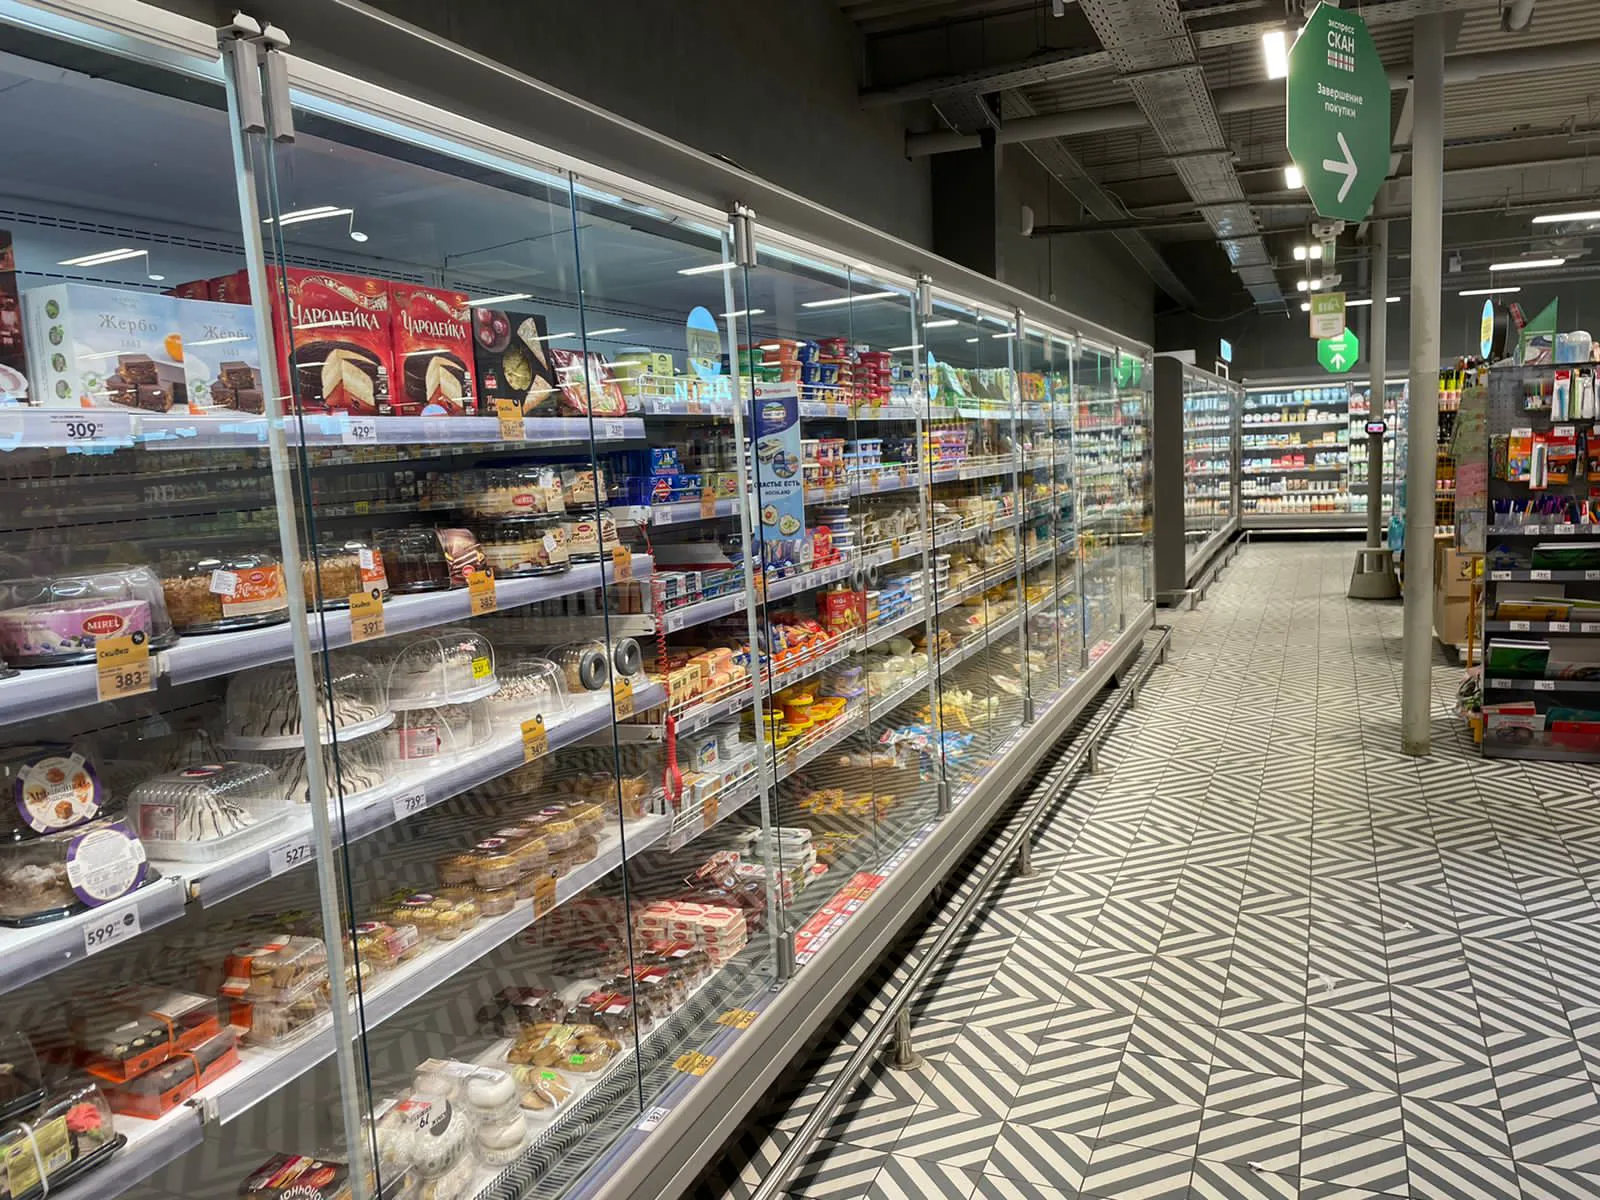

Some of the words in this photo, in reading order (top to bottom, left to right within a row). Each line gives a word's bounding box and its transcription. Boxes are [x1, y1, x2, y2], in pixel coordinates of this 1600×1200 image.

[1328, 19, 1355, 34] экспресс
[1327, 30, 1355, 54] СКАН
[1317, 82, 1363, 104] Завершение
[1324, 102, 1356, 118] покупки
[98, 314, 158, 333] Жербо
[401, 310, 466, 338] ЧАРОДЕЙКА
[66, 423, 96, 437] 309
[352, 425, 370, 437] 429
[87, 616, 121, 630] MIREL
[362, 622, 378, 634] 391
[115, 671, 142, 688] 383
[405, 795, 420, 809] 739
[286, 846, 304, 863] 527
[87, 924, 114, 945] 599
